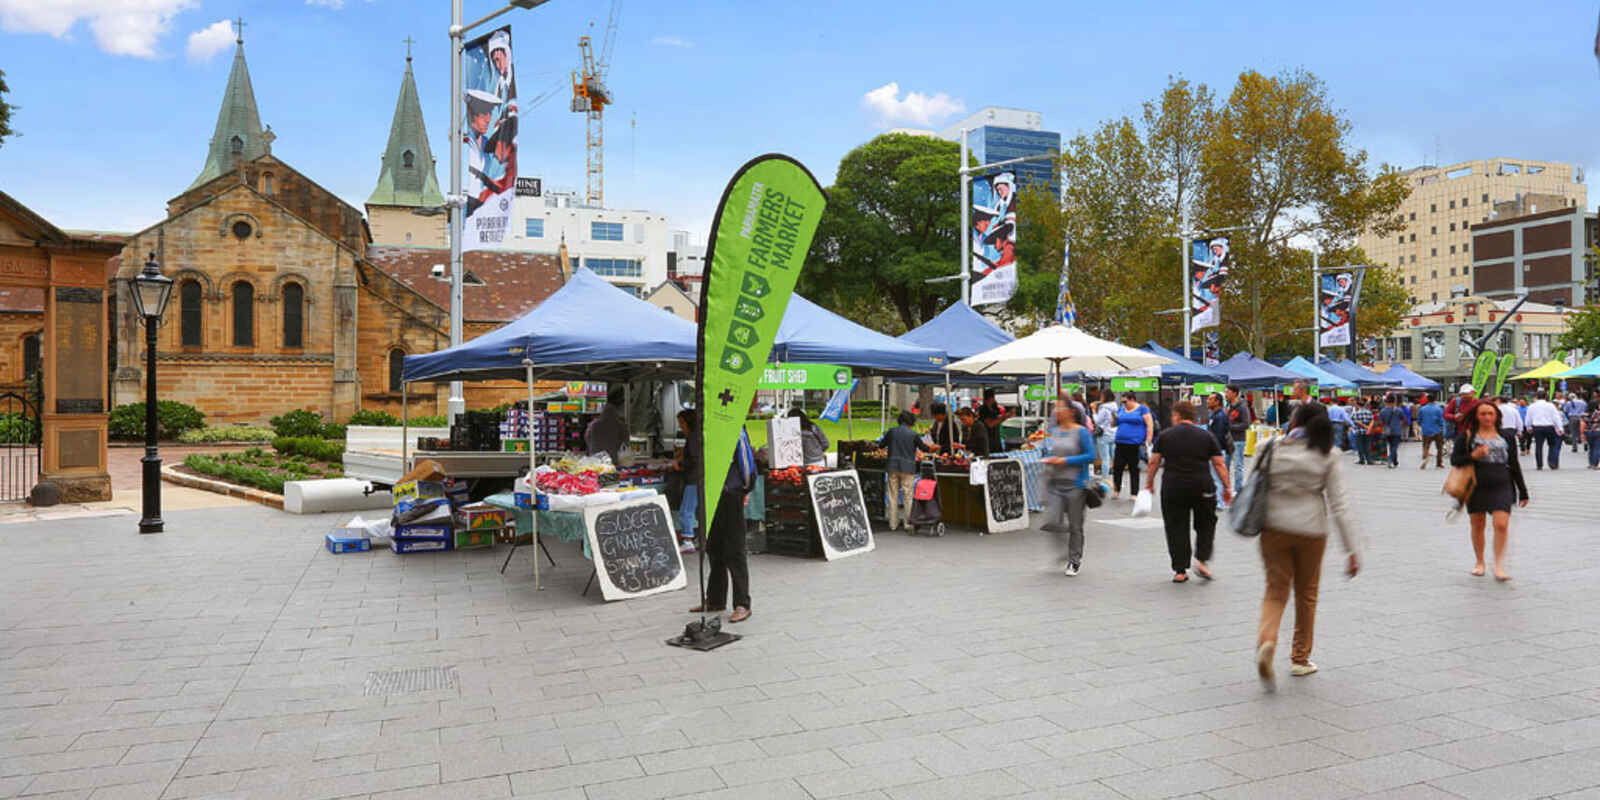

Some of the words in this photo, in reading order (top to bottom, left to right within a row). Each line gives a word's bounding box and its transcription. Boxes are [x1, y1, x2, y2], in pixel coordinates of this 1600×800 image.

[516, 179, 539, 189] HINE
[747, 188, 784, 269] FARMERS
[770, 195, 806, 270] MARKET
[764, 368, 786, 384] FRUIT
[787, 369, 807, 383] SHED
